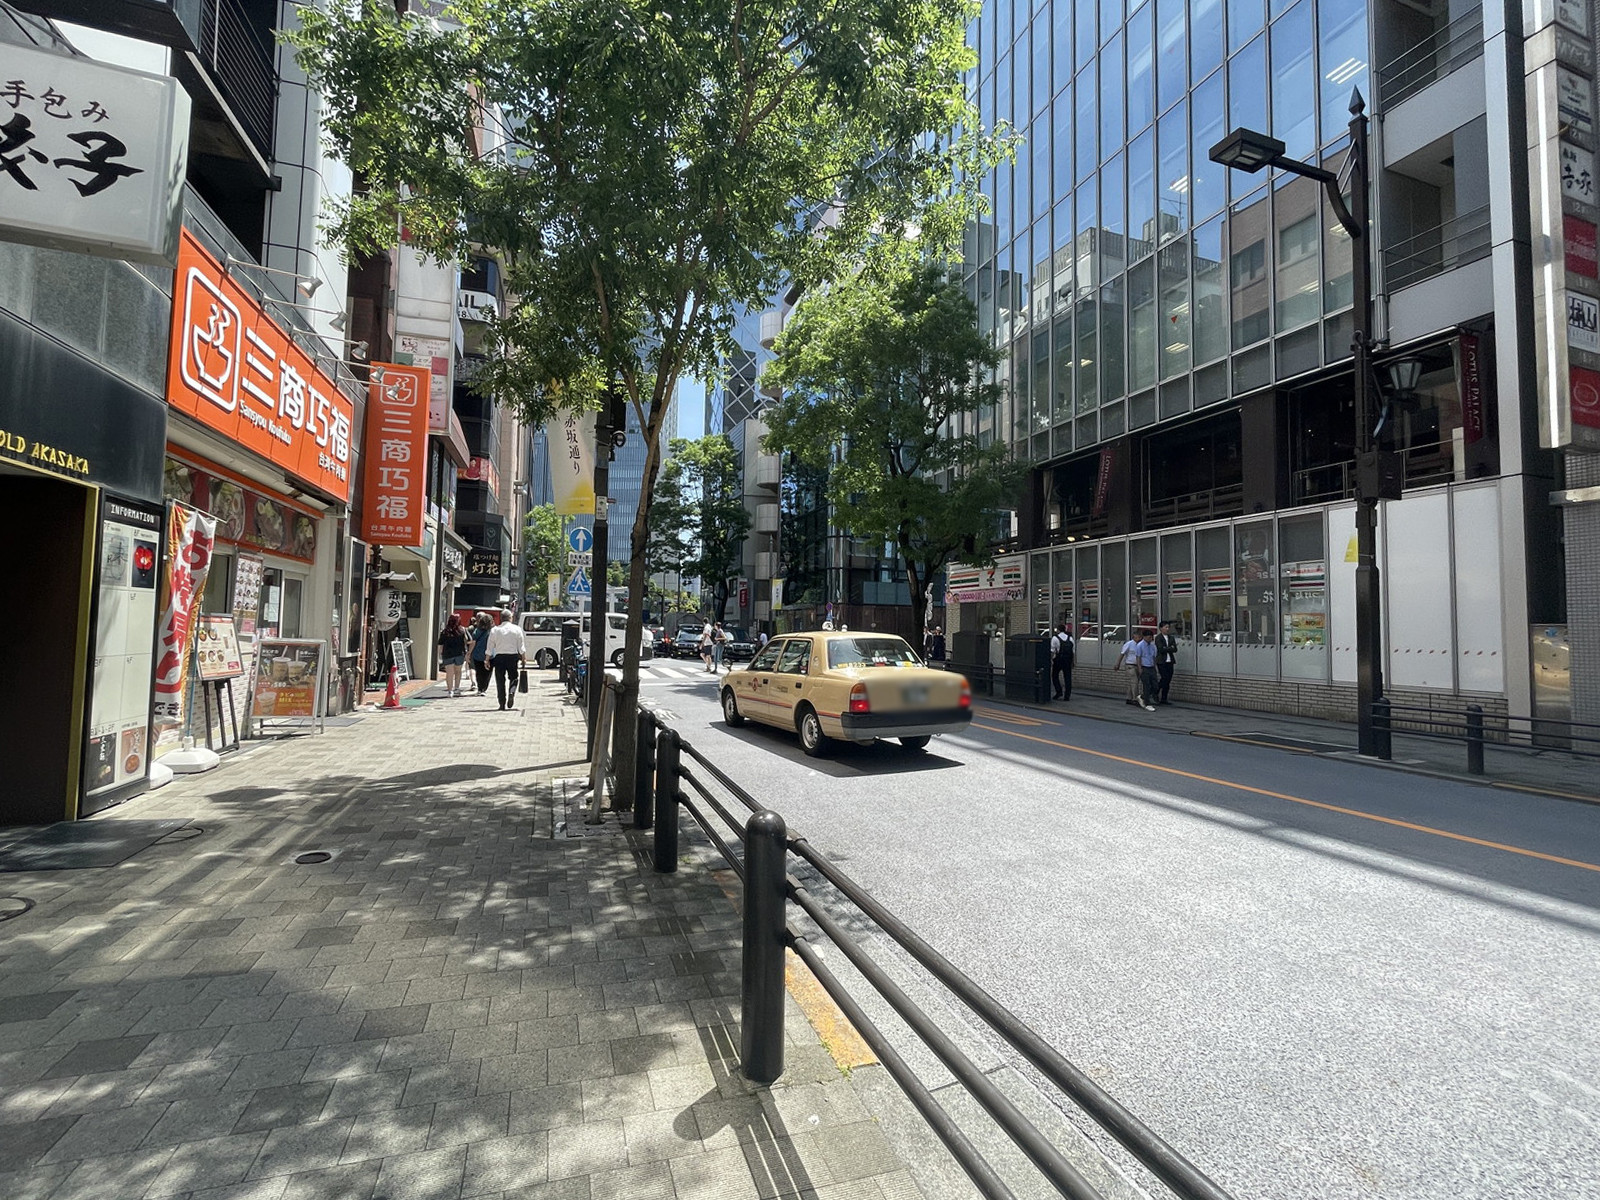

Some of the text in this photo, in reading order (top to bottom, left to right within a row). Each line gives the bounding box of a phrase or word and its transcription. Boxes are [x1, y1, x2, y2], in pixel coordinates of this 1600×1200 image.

[0, 80, 109, 123] 手包み
[241, 327, 350, 462] 三商巧福
[31, 442, 89, 475] AKASAKA
[376, 410, 412, 519] 三商巧福
[565, 416, 582, 476] 赤坂通り
[110, 503, 155, 524] INFORMATION
[472, 561, 500, 576] 灯花
